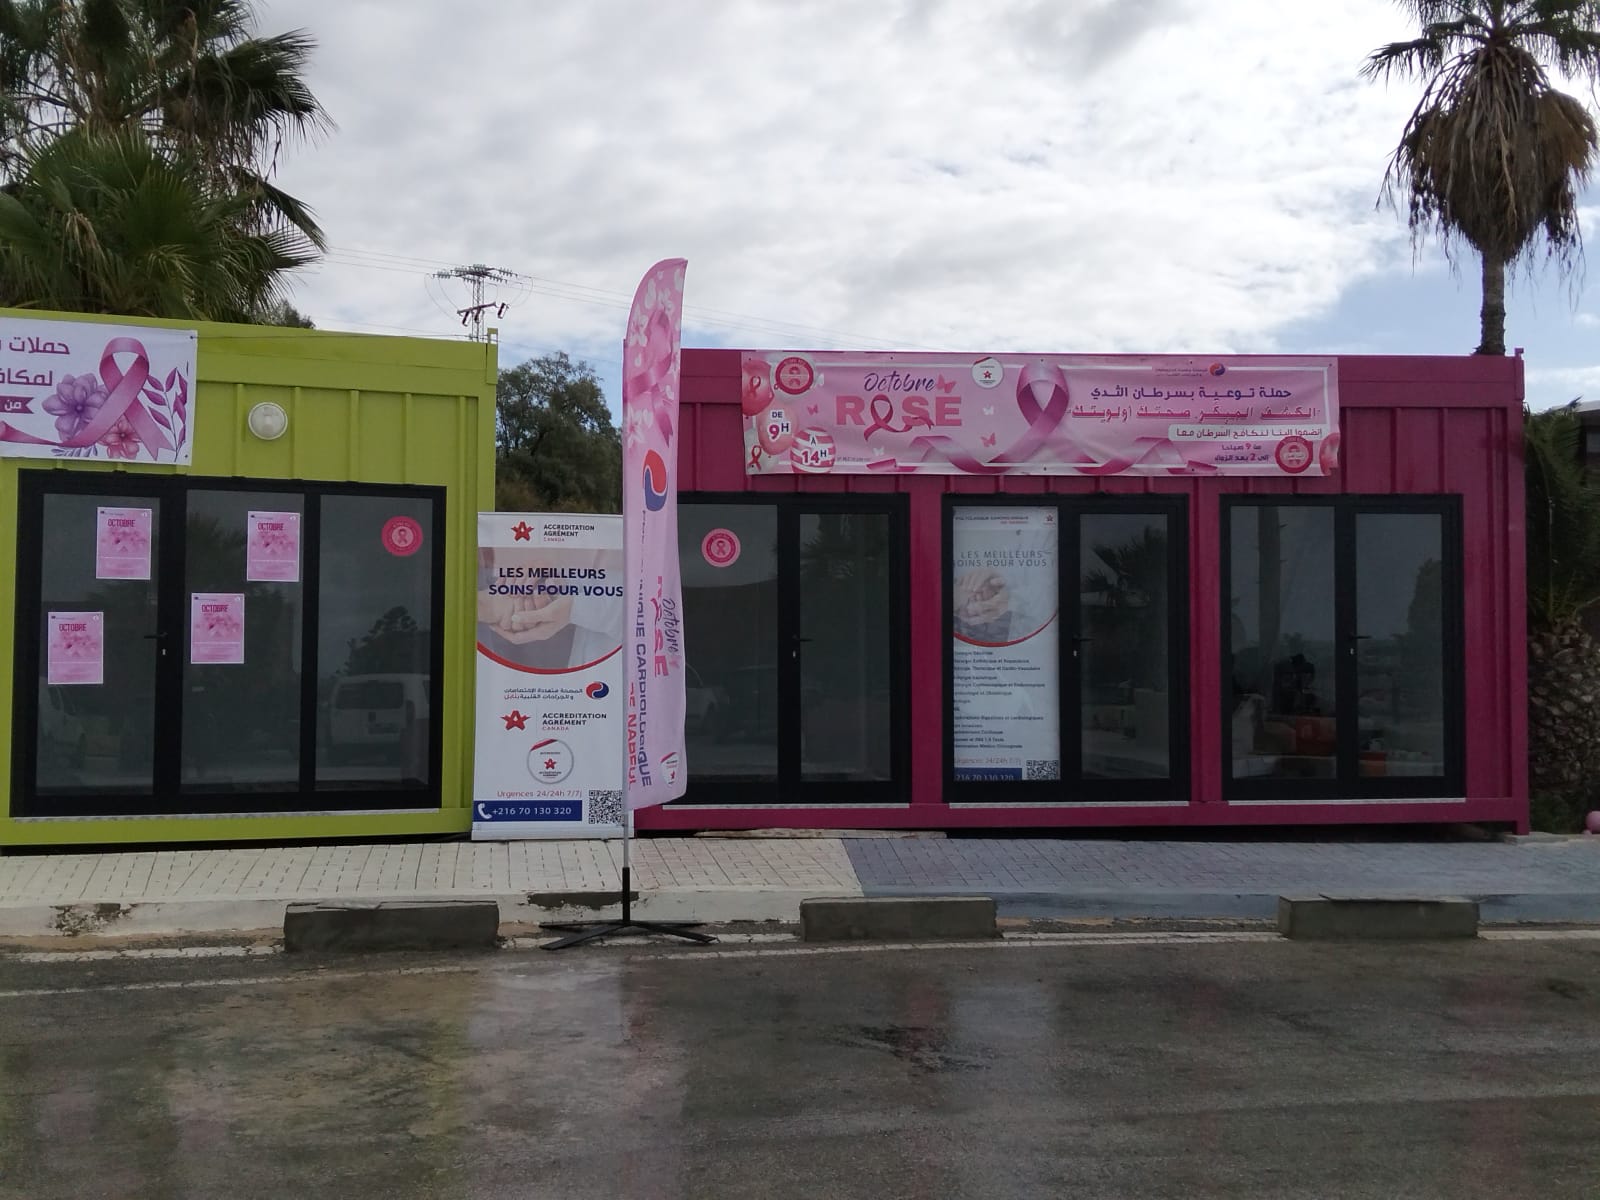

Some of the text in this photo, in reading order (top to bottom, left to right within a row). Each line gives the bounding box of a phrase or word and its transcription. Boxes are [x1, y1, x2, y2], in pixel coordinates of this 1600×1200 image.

[9, 336, 70, 355] حملات
[864, 371, 935, 392] Octobre
[1091, 386, 1291, 400] حملة توعية بسرطان الثدي
[771, 411, 783, 419] DE
[836, 394, 962, 428] ROSE
[1197, 428, 1230, 438] السرطان
[1250, 453, 1256, 461] 2
[107, 518, 136, 528] OCTOBRE
[257, 522, 284, 531] OCTOBRE
[954, 559, 1047, 568] OINS POUR VOUS
[500, 567, 606, 579] LES MEILLEURS
[489, 584, 623, 597] SOINS POUR VOUS
[201, 604, 229, 613] OCTOBRE
[59, 623, 87, 632] OCTOBRE
[542, 718, 587, 726] AGRÉMENT
[497, 790, 534, 799] Urgences
[536, 790, 565, 798] 24/24h
[492, 807, 572, 815] +216 70 130 320
